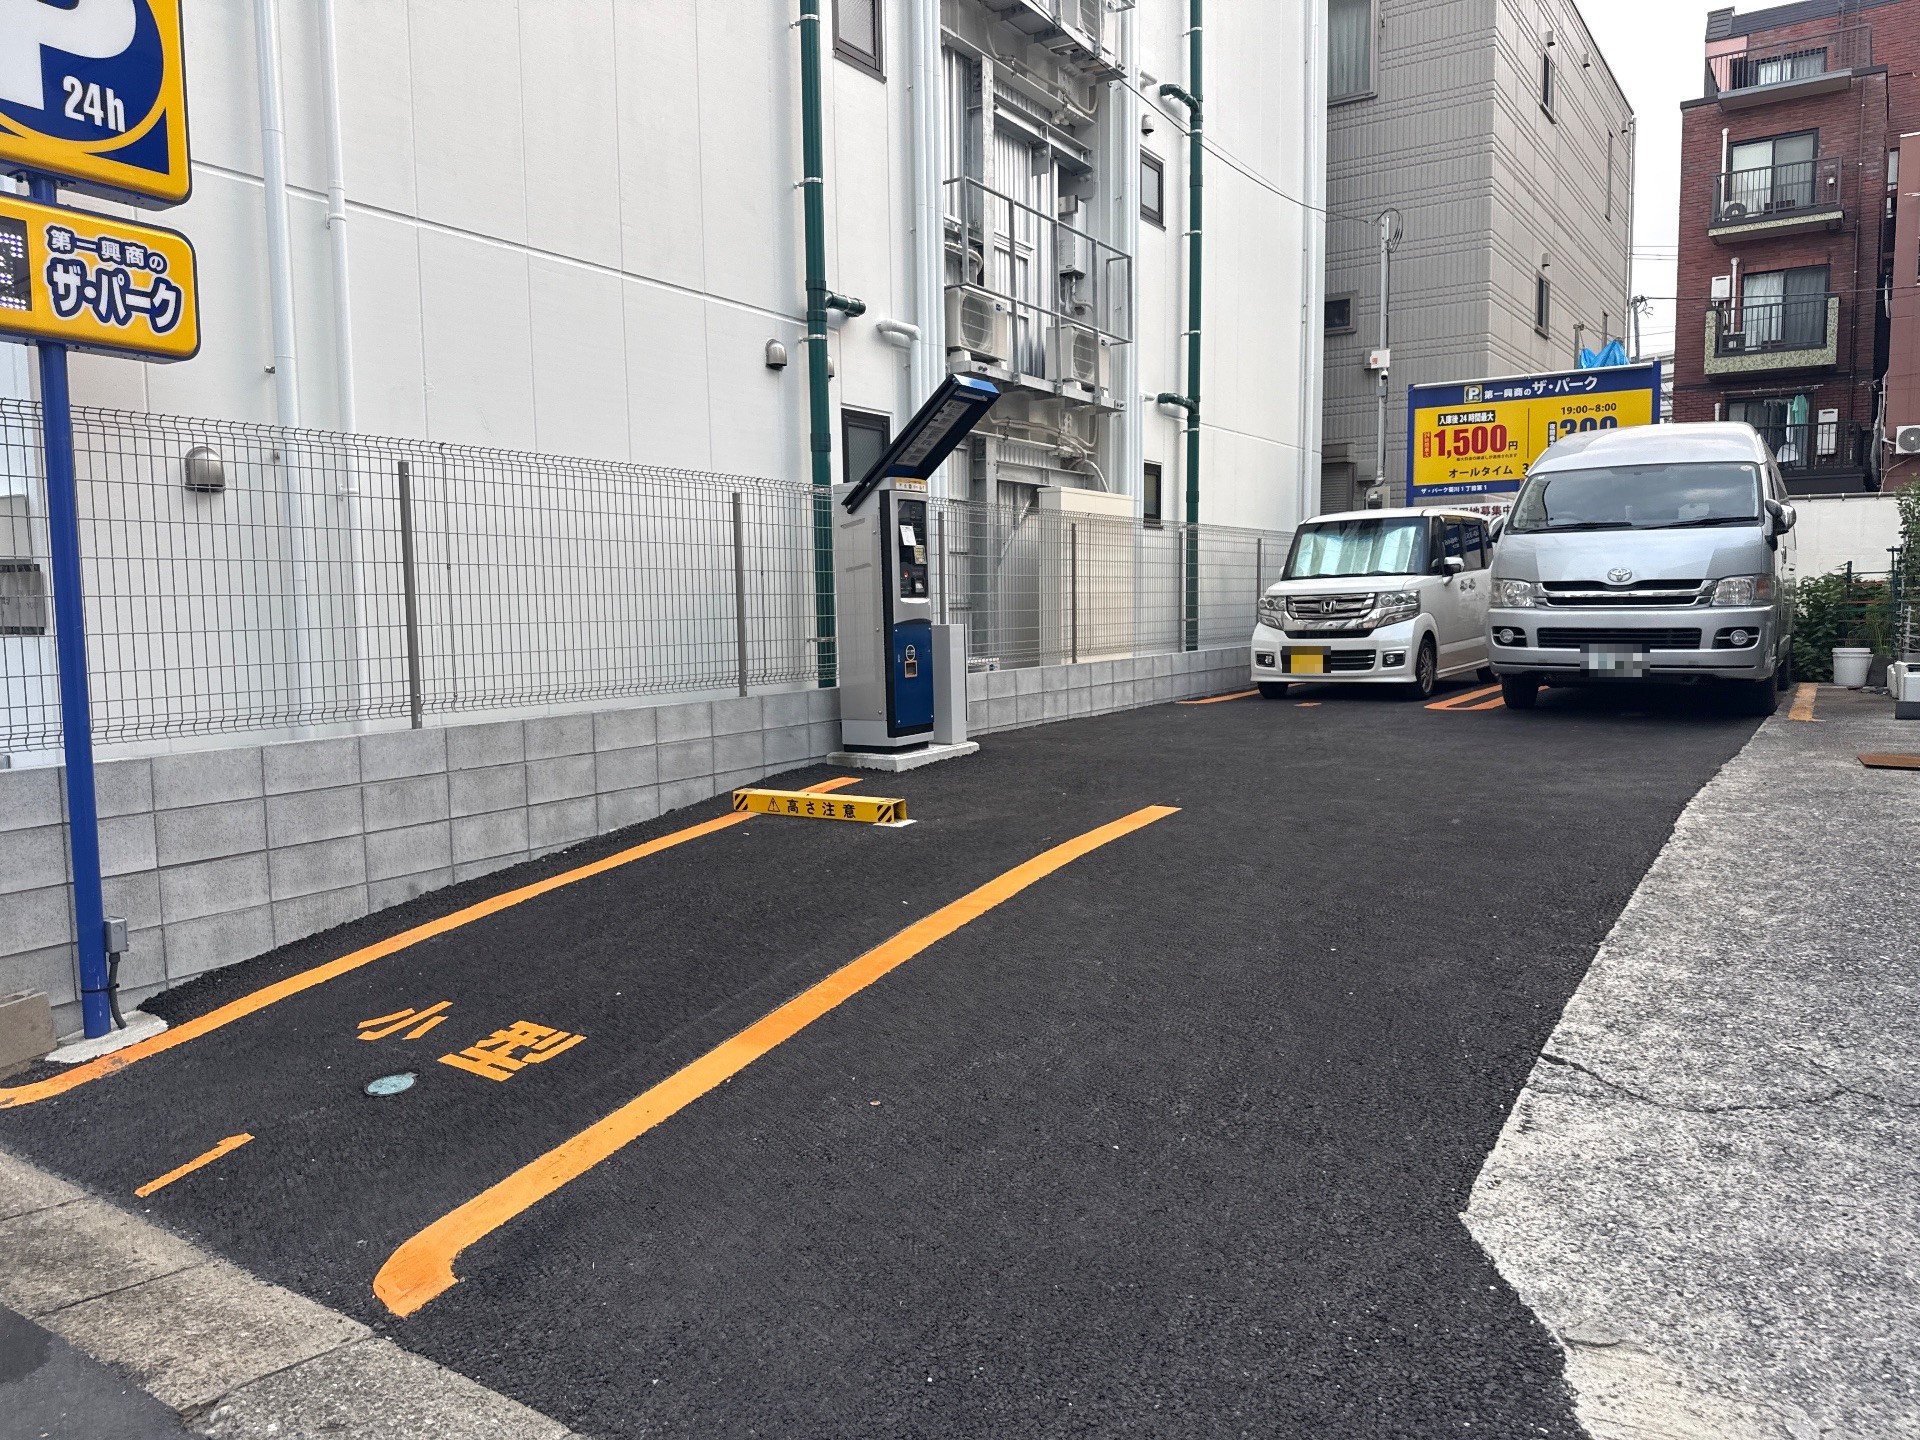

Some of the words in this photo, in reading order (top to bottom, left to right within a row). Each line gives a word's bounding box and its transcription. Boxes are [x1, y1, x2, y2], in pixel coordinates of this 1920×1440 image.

[62, 75, 126, 133] 24h
[50, 228, 165, 272] 第一興商の
[52, 263, 179, 329] ザ・パーク
[1449, 465, 1513, 479] オールタイム
[786, 798, 857, 819] 高さ注意
